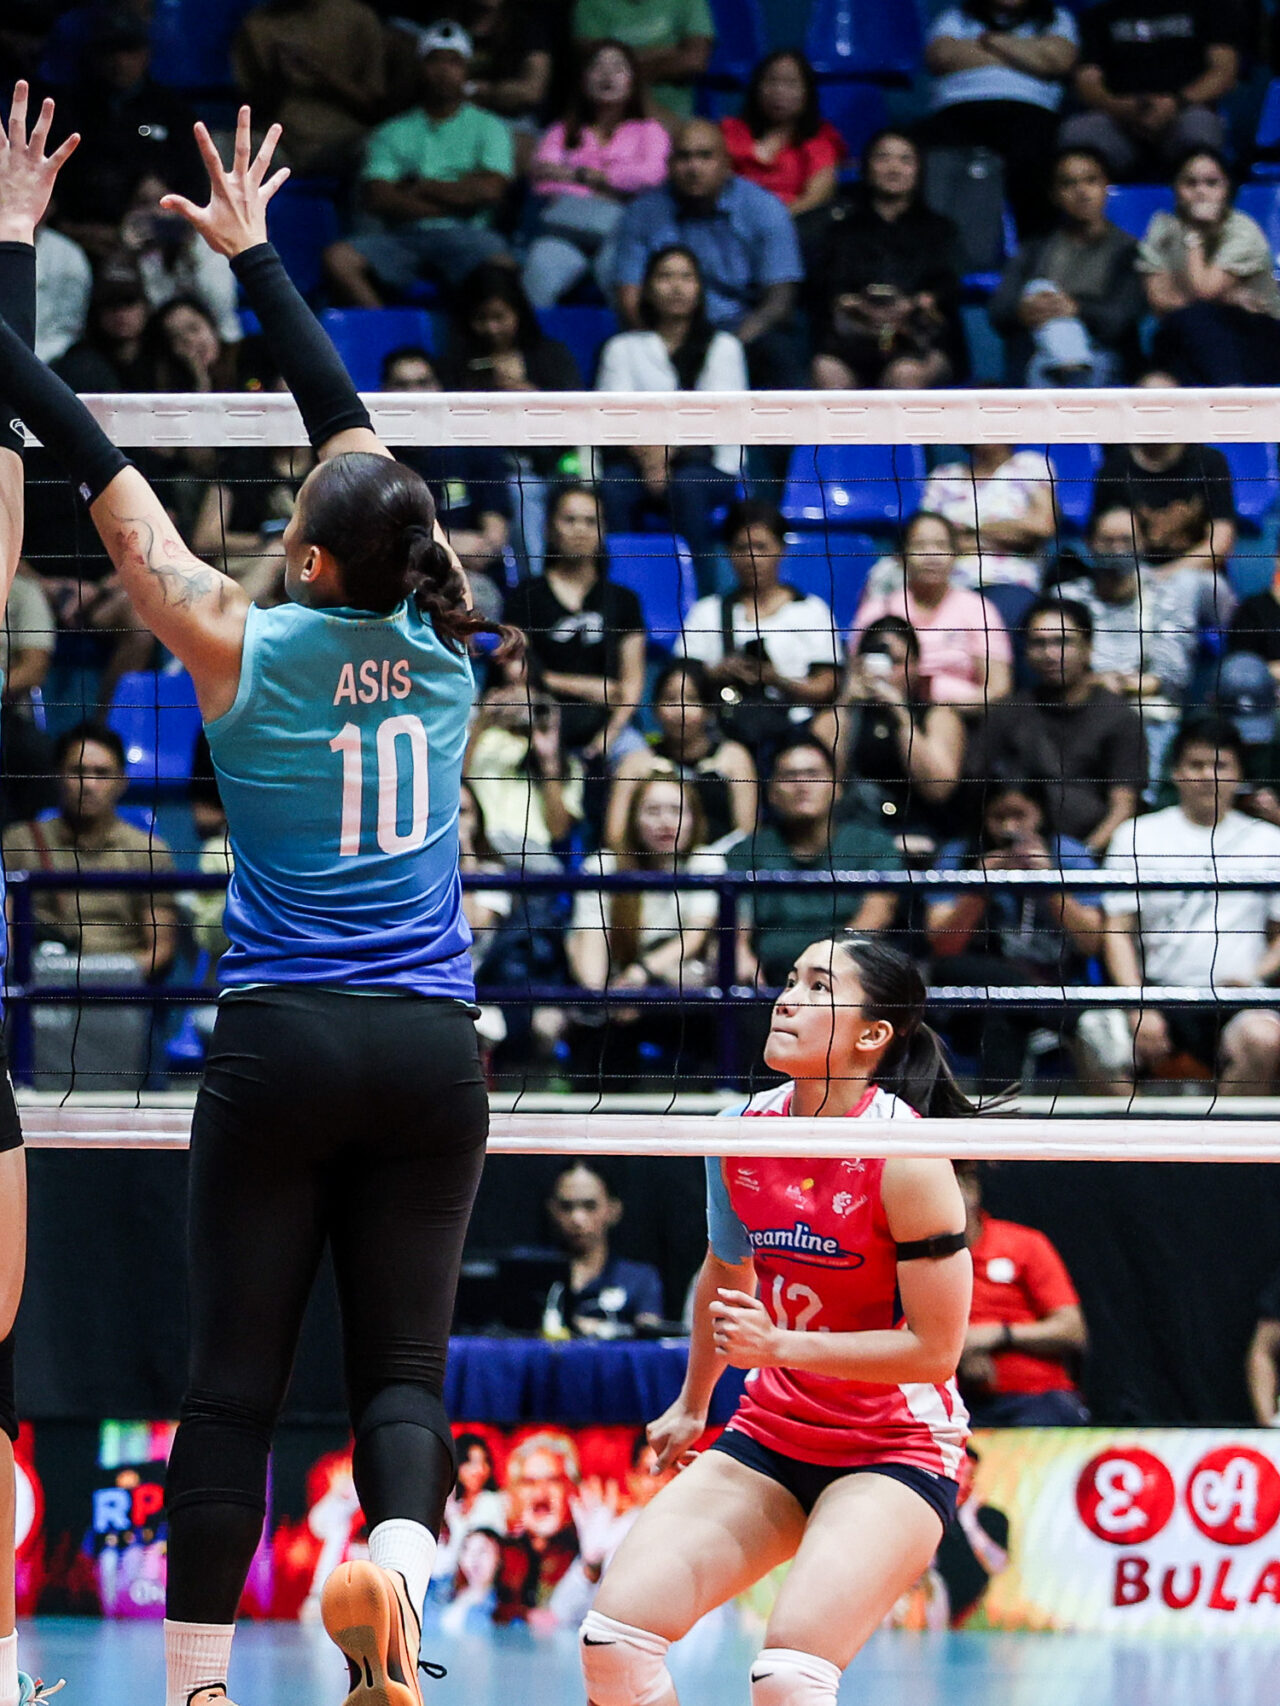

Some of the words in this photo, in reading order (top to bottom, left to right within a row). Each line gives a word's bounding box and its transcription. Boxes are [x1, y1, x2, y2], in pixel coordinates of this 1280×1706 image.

[333, 659, 412, 706] ASIS
[329, 714, 429, 857] 10
[749, 1223, 838, 1253] reamline
[772, 1274, 830, 1332] 12
[91, 1482, 165, 1534] RP
[1094, 1456, 1258, 1533] EA
[1112, 1556, 1280, 1611] BULA
